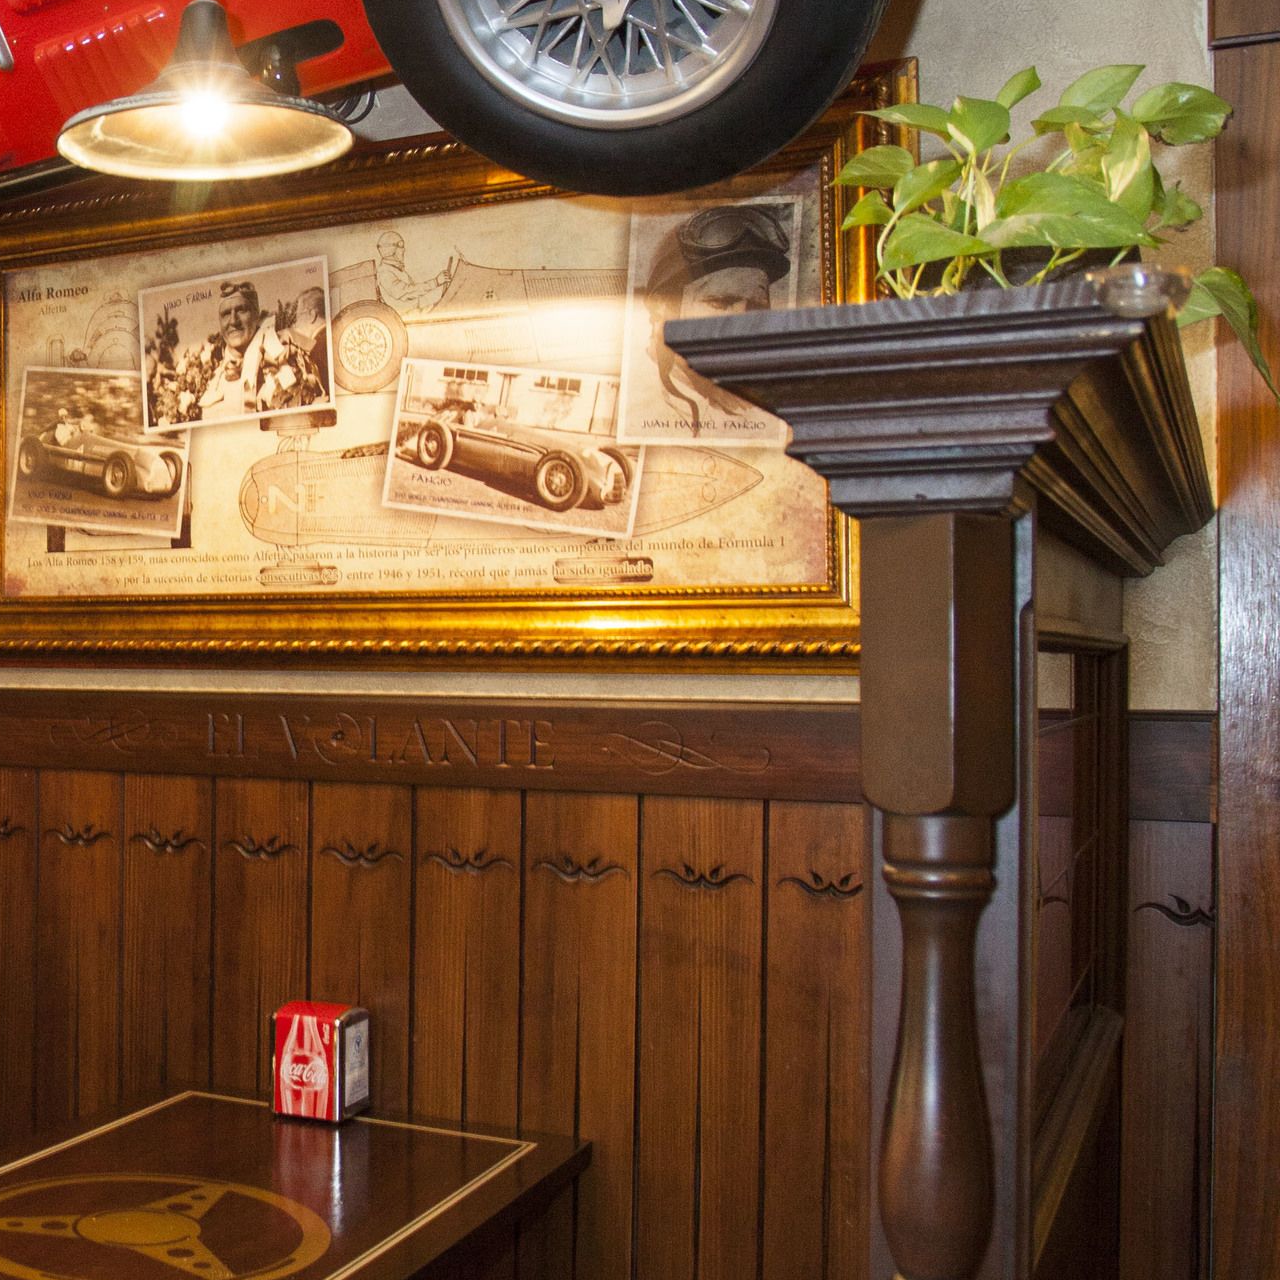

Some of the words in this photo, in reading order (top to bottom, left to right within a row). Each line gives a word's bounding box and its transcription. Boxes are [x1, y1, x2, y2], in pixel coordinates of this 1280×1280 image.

[17, 289, 42, 303] Alfa
[47, 286, 88, 299] Romeo
[642, 419, 670, 429] JUAN
[723, 419, 766, 430] FANGIO
[411, 473, 452, 487] FANGIO
[27, 557, 42, 568] Los
[46, 557, 63, 567] Alfa
[66, 557, 98, 567] Romeo
[149, 554, 168, 564] más
[170, 551, 221, 563] conocidos
[222, 554, 250, 563] como
[293, 552, 334, 564] pasaron
[336, 551, 342, 560] a
[346, 549, 355, 560] la
[358, 546, 399, 559] historia
[402, 548, 421, 561] por
[445, 545, 460, 557] los
[464, 544, 516, 560] primeros
[519, 543, 550, 555] autos
[554, 541, 621, 556] campeones
[625, 540, 644, 552] del
[648, 538, 694, 551] mundo
[698, 538, 714, 549] de
[719, 535, 775, 549] Fórmula
[780, 535, 786, 547] 1
[124, 576, 139, 588] por
[142, 573, 151, 584] la
[196, 572, 208, 583] de
[211, 571, 252, 583] victorias
[255, 570, 319, 582] consecutivas
[346, 569, 374, 580] entre
[378, 568, 403, 579] 1946
[489, 568, 509, 582] que
[552, 563, 566, 576] ha
[570, 562, 594, 576] sido
[206, 713, 259, 759] EL
